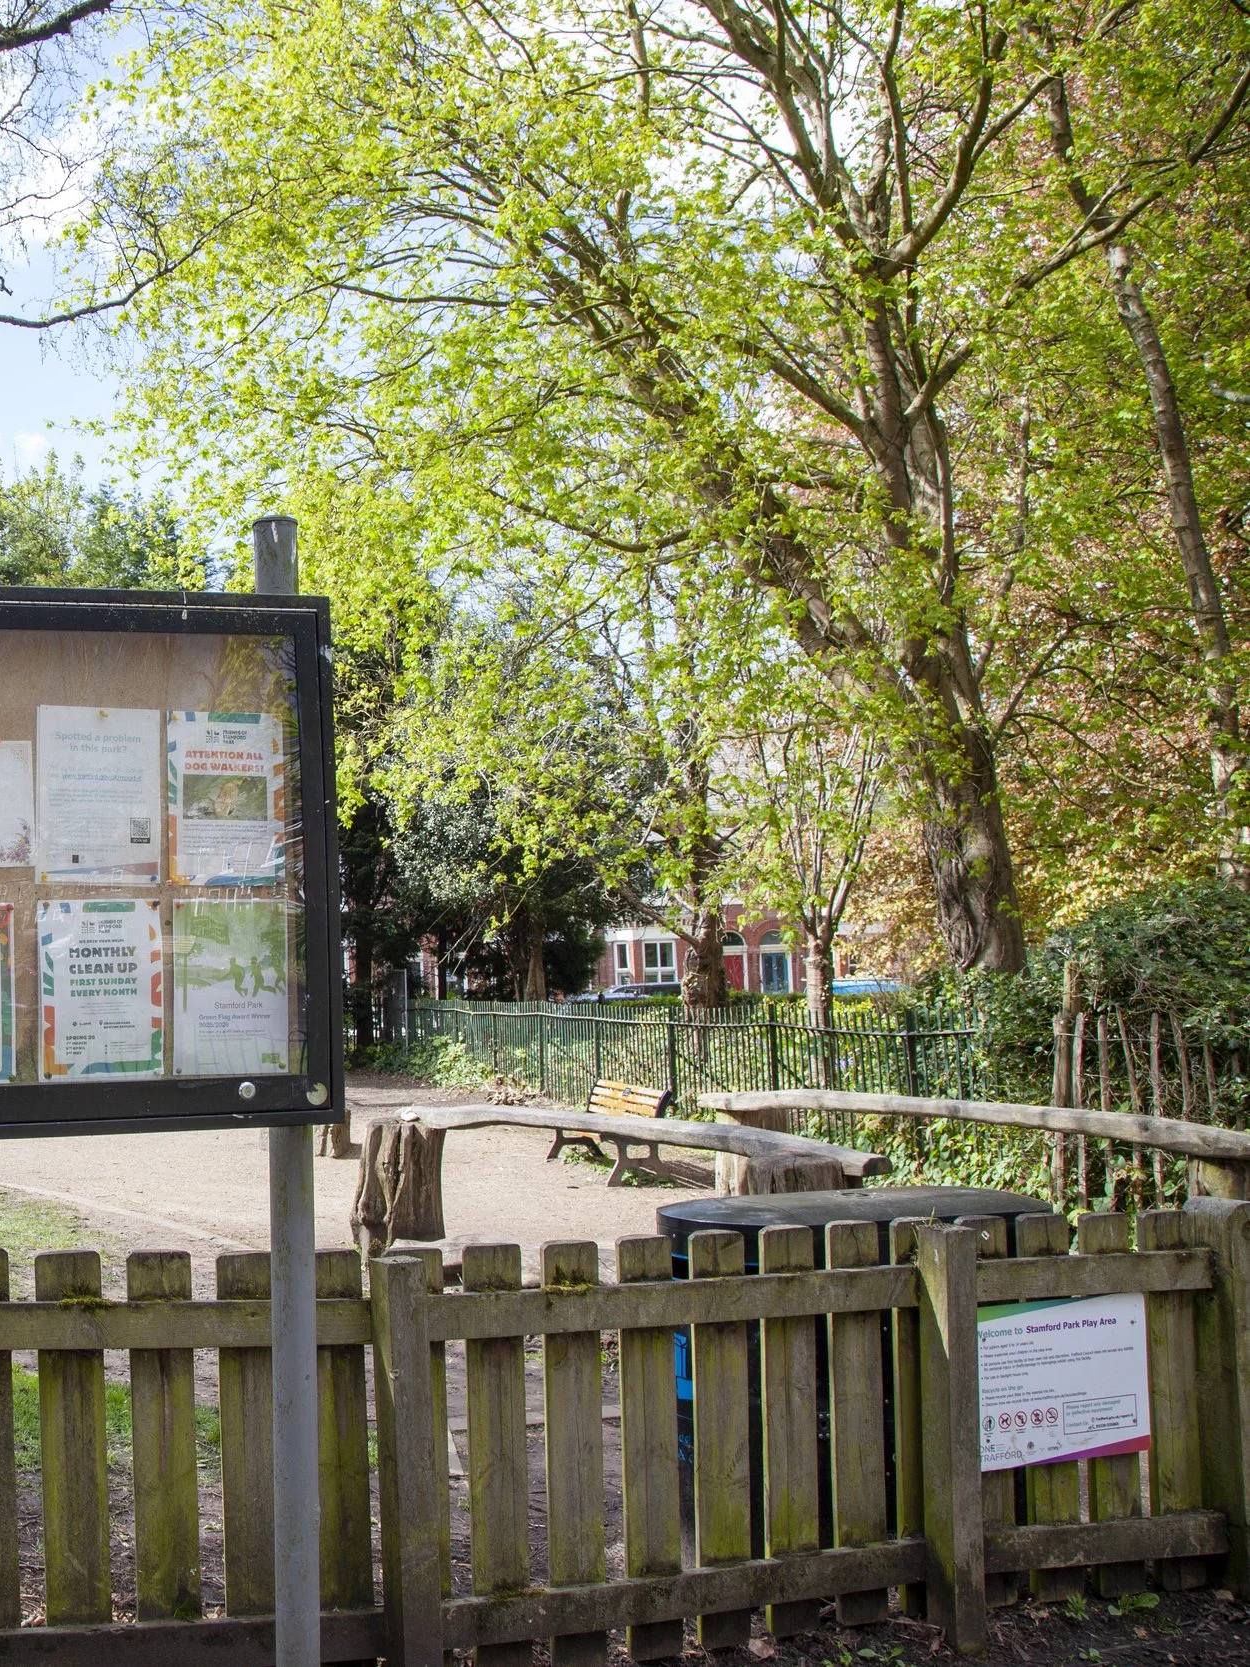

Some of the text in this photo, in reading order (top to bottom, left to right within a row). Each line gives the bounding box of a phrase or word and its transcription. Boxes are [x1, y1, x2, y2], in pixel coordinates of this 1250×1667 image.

[56, 732, 92, 741] Spotted
[81, 744, 99, 752] this
[102, 745, 127, 754] park?
[185, 750, 263, 760] ATTENTION ALL
[210, 763, 264, 772] WALKERS!
[69, 946, 136, 958] MONTHLY
[69, 963, 137, 974] CLEAN UP
[1026, 1321, 1061, 1334] Stamford
[1063, 1320, 1080, 1330] Park
[1082, 1318, 1098, 1329] Play
[1099, 1317, 1117, 1326] Area
